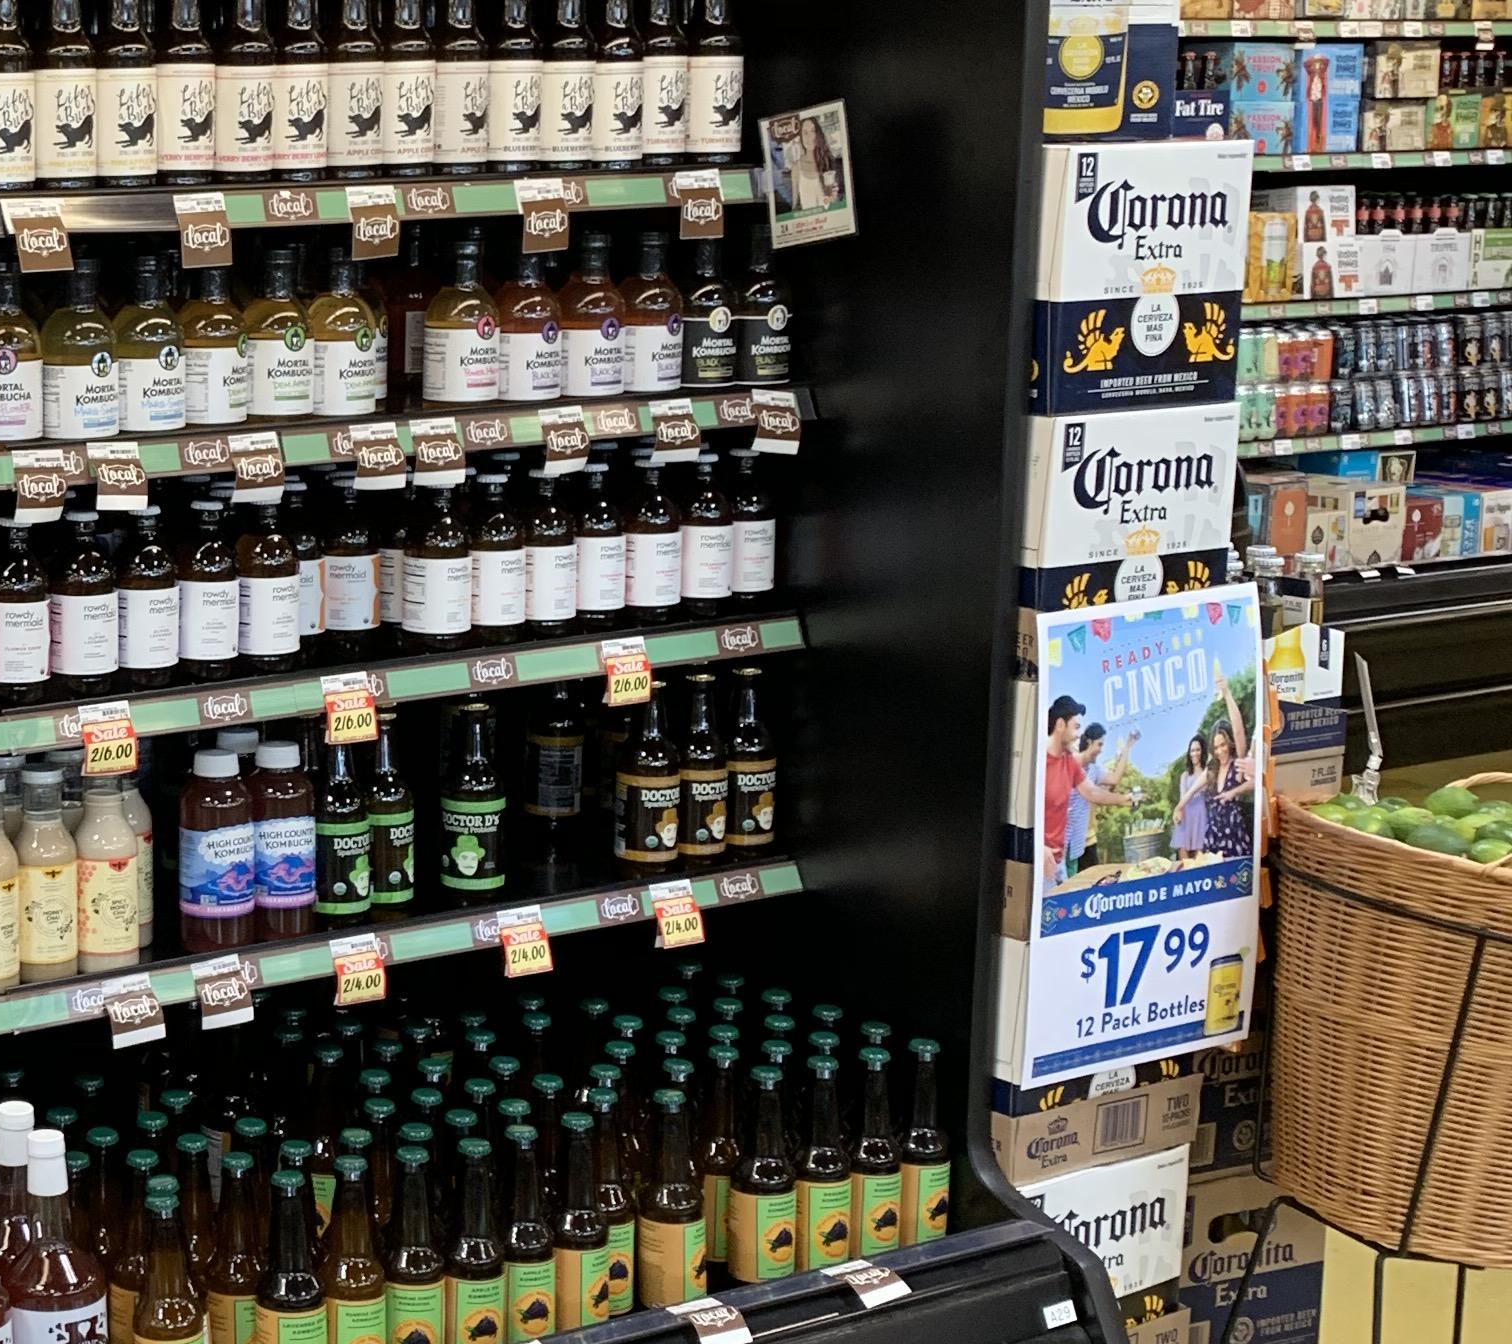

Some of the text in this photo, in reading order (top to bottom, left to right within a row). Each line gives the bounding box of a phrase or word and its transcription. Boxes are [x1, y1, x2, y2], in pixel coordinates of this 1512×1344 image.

[1175, 100, 1224, 117] Fat Tire
[1081, 157, 1095, 178] 12
[1087, 179, 1230, 250] Corona
[1134, 237, 1183, 261] Extra
[1103, 285, 1134, 295] SINCE
[1137, 313, 1173, 323] CERVEZA
[1150, 304, 1161, 313] LA
[1144, 333, 1163, 343] FINA
[1146, 324, 1164, 333] MAS
[278, 359, 308, 369] MORTAL
[1067, 426, 1082, 447] 12
[1073, 446, 1215, 515] Corona
[1119, 500, 1167, 525] Extra
[1121, 574, 1158, 584] CERVEZA
[1102, 641, 1166, 673] READY
[1104, 648, 1207, 724] CINCO
[334, 713, 372, 731] 2/6.00
[90, 726, 128, 740] Sale
[91, 743, 132, 762] 2/6.00
[1148, 879, 1212, 902] DE MAYO
[665, 918, 698, 935] 2/4.00
[511, 944, 546, 963] 2/4.00
[343, 974, 381, 993] 2/4.00
[1076, 997, 1205, 1039] 12 Pack Bottles
[1166, 1095, 1190, 1112] TWO
[1050, 1305, 1072, 1324] A29
